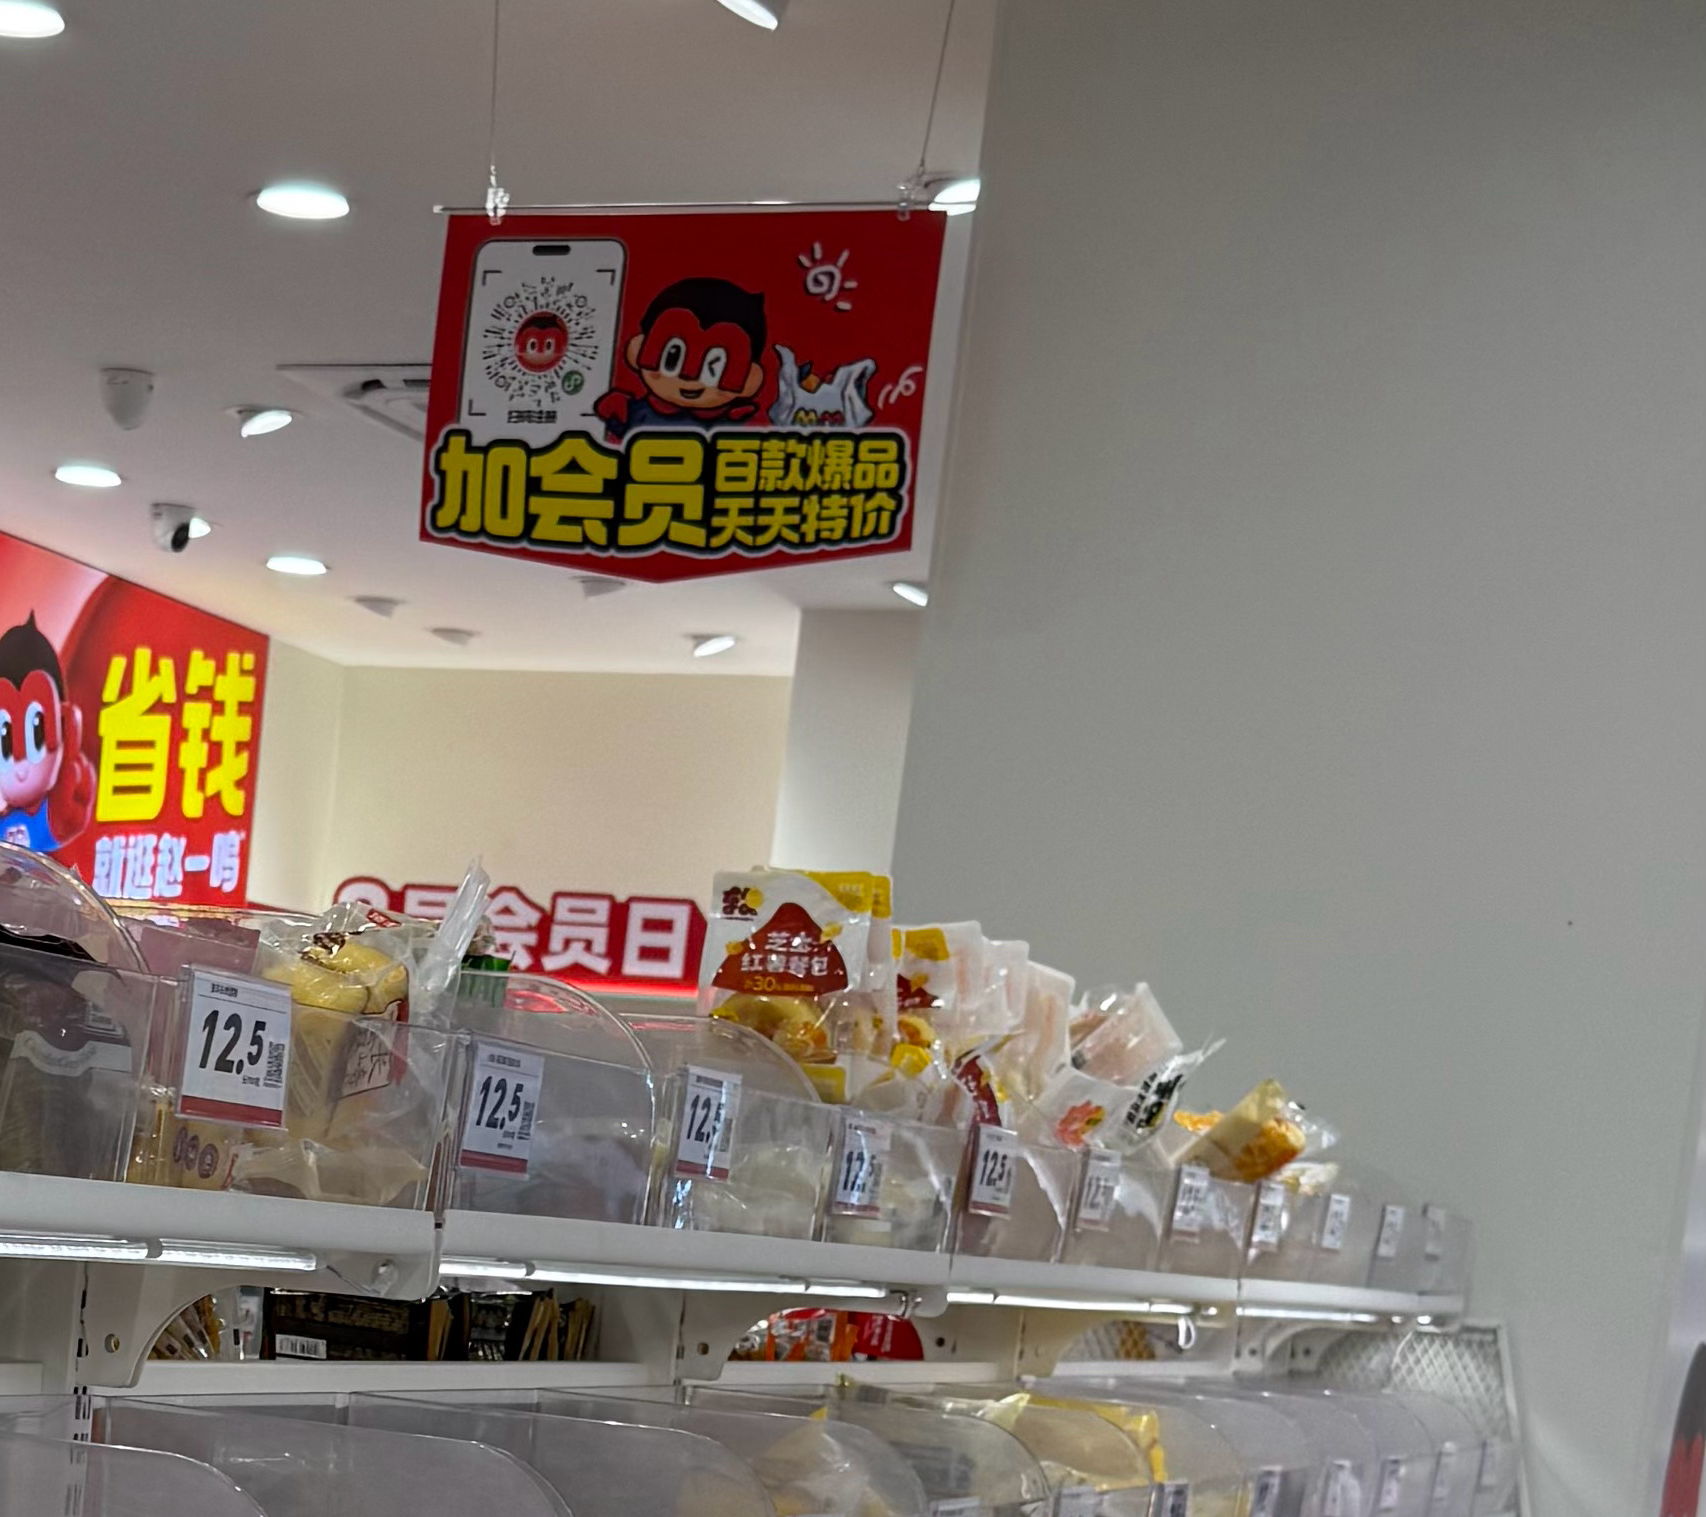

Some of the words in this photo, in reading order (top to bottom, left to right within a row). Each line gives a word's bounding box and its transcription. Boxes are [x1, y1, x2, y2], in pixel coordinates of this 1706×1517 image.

[435, 436, 706, 548] 加会员
[714, 439, 900, 492] 百款爆品
[709, 494, 896, 548] 天天特价
[96, 646, 256, 823] 省钱
[198, 1009, 267, 1075] 12.5
[475, 1076, 524, 1130] 12.5
